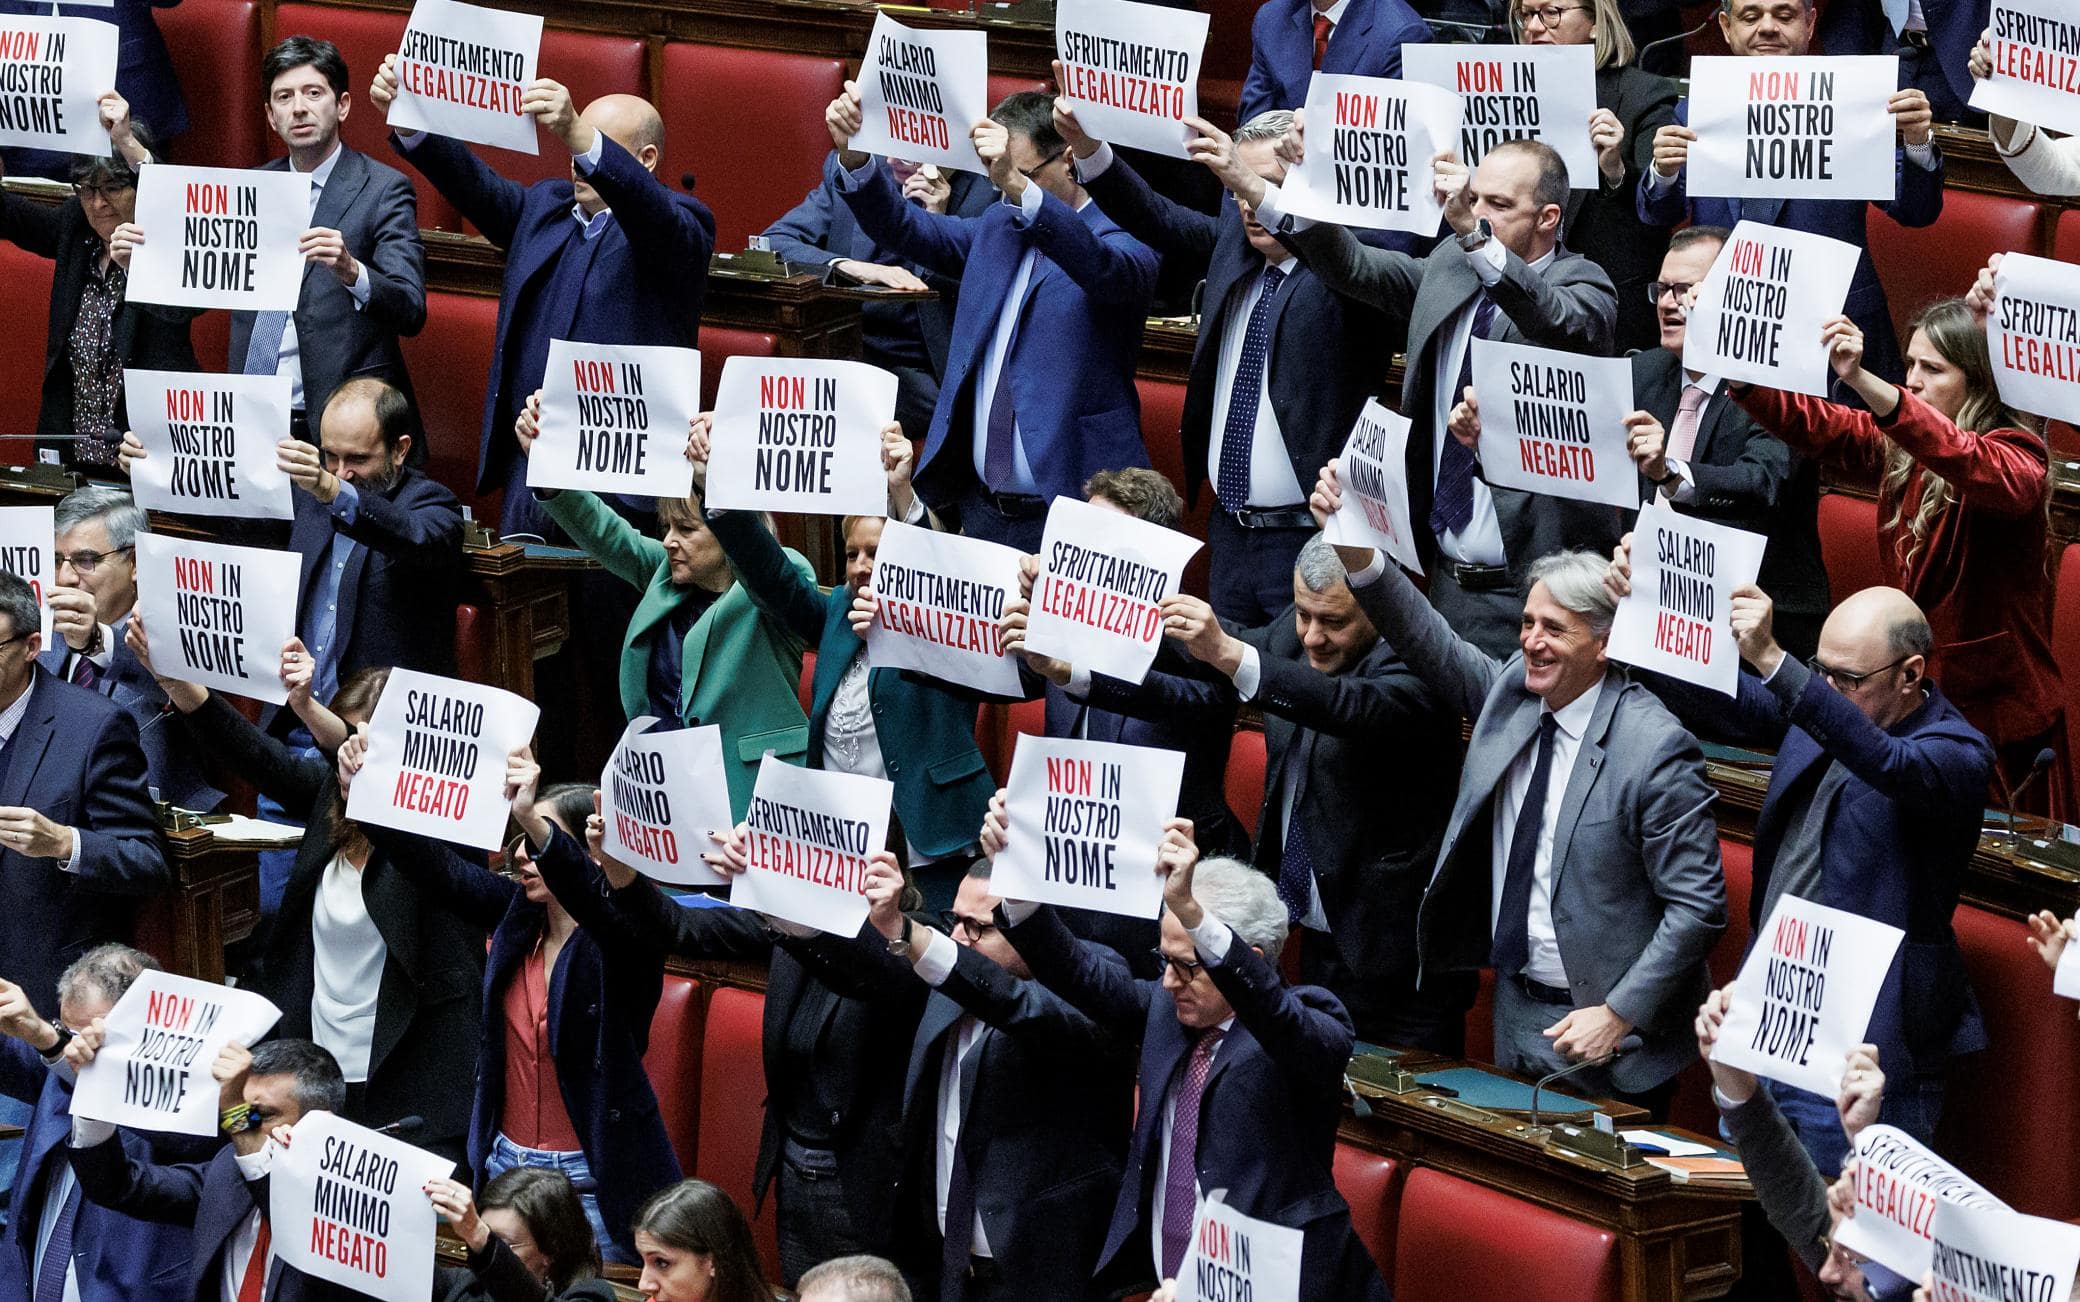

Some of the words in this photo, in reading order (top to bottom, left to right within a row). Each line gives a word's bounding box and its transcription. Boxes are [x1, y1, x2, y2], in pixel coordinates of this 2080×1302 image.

[45, 33, 65, 62] IN
[404, 29, 524, 82] SFRUTTAMENTO
[879, 34, 936, 77] SALARIO
[1065, 30, 1188, 83] SFRUTTAMENTO
[1997, 41, 2080, 94] LEGALIZ
[403, 61, 522, 116] LEGALIZZATO
[879, 70, 943, 114] MINIMO
[1066, 64, 1183, 120] LEGALIZZATO
[1457, 62, 1502, 92] NON
[1513, 62, 1536, 93] IN
[1751, 72, 1798, 99] NON
[1810, 72, 1833, 101] IN
[887, 106, 949, 150] NEGATO
[1336, 92, 1377, 128] NON
[1385, 98, 1407, 131] IN
[1748, 104, 1833, 136] NOSTRO
[1334, 128, 1407, 167] NOSTRO
[1746, 139, 1832, 180] NOME
[187, 184, 227, 215] NON
[237, 186, 256, 216] IN
[1335, 163, 1409, 211] NOME
[185, 216, 257, 250] NOSTRO
[182, 250, 257, 291] NOME
[1731, 240, 1763, 277] NON
[1770, 247, 1792, 282] IN
[1723, 275, 1786, 320] NOSTRO
[2001, 296, 2080, 344] SFRUTTA
[1717, 312, 1782, 367] NOME
[574, 360, 615, 393] NON
[622, 363, 643, 395] IN
[761, 376, 804, 409] NON
[815, 378, 836, 411] IN
[1511, 361, 1586, 404] SALARIO
[167, 389, 204, 421] NON
[214, 391, 233, 423] IN
[577, 394, 648, 430] NOSTRO
[1514, 400, 1590, 444] MINIMO
[168, 423, 234, 458] NOSTRO
[576, 429, 647, 475] NOME
[759, 412, 836, 448] NOSTRO
[171, 456, 240, 500] NOME
[755, 448, 833, 493] NOME
[1350, 454, 1387, 505] MINIMO
[1519, 438, 1594, 482] NEGATO
[1049, 541, 1167, 604] SFRUTTAMENTO
[1658, 528, 1715, 578] SALARIO
[175, 557, 213, 594] NON
[222, 563, 240, 598] IN
[877, 562, 1005, 620] SFRUTTAMENTO
[1660, 568, 1714, 622] MINIMO
[177, 592, 243, 634] NOSTRO
[877, 599, 1004, 657] LEGALIZZATO
[1042, 577, 1160, 643] LEGALIZZATO
[179, 628, 249, 679] NOME
[1655, 611, 1712, 664] NEGATO
[406, 690, 483, 738] SALARIO
[402, 730, 478, 780] MINIMO
[394, 771, 469, 820] NEGATO
[613, 771, 671, 826] MINIMO
[1047, 757, 1091, 796] NON
[1101, 763, 1121, 800] IN
[616, 810, 678, 864] NEGATO
[1045, 796, 1120, 840] NOSTRO
[749, 831, 867, 895] LEGALIZZATO
[1045, 835, 1116, 890] NOME
[1776, 920, 1807, 960] NON
[1812, 926, 1833, 968] IN
[1766, 958, 1824, 1012] NOSTRO
[147, 991, 193, 1031] NON
[194, 1003, 222, 1034] IN
[1752, 1001, 1819, 1066] NOME
[131, 1028, 203, 1067] NOSTRO
[125, 1060, 189, 1113] NOME
[320, 1136, 398, 1195] SALARIO
[314, 1176, 390, 1238] MINIMO
[311, 1217, 386, 1278] NEGATO
[1199, 1217, 1230, 1264] NON
[1236, 1231, 1250, 1275] IN
